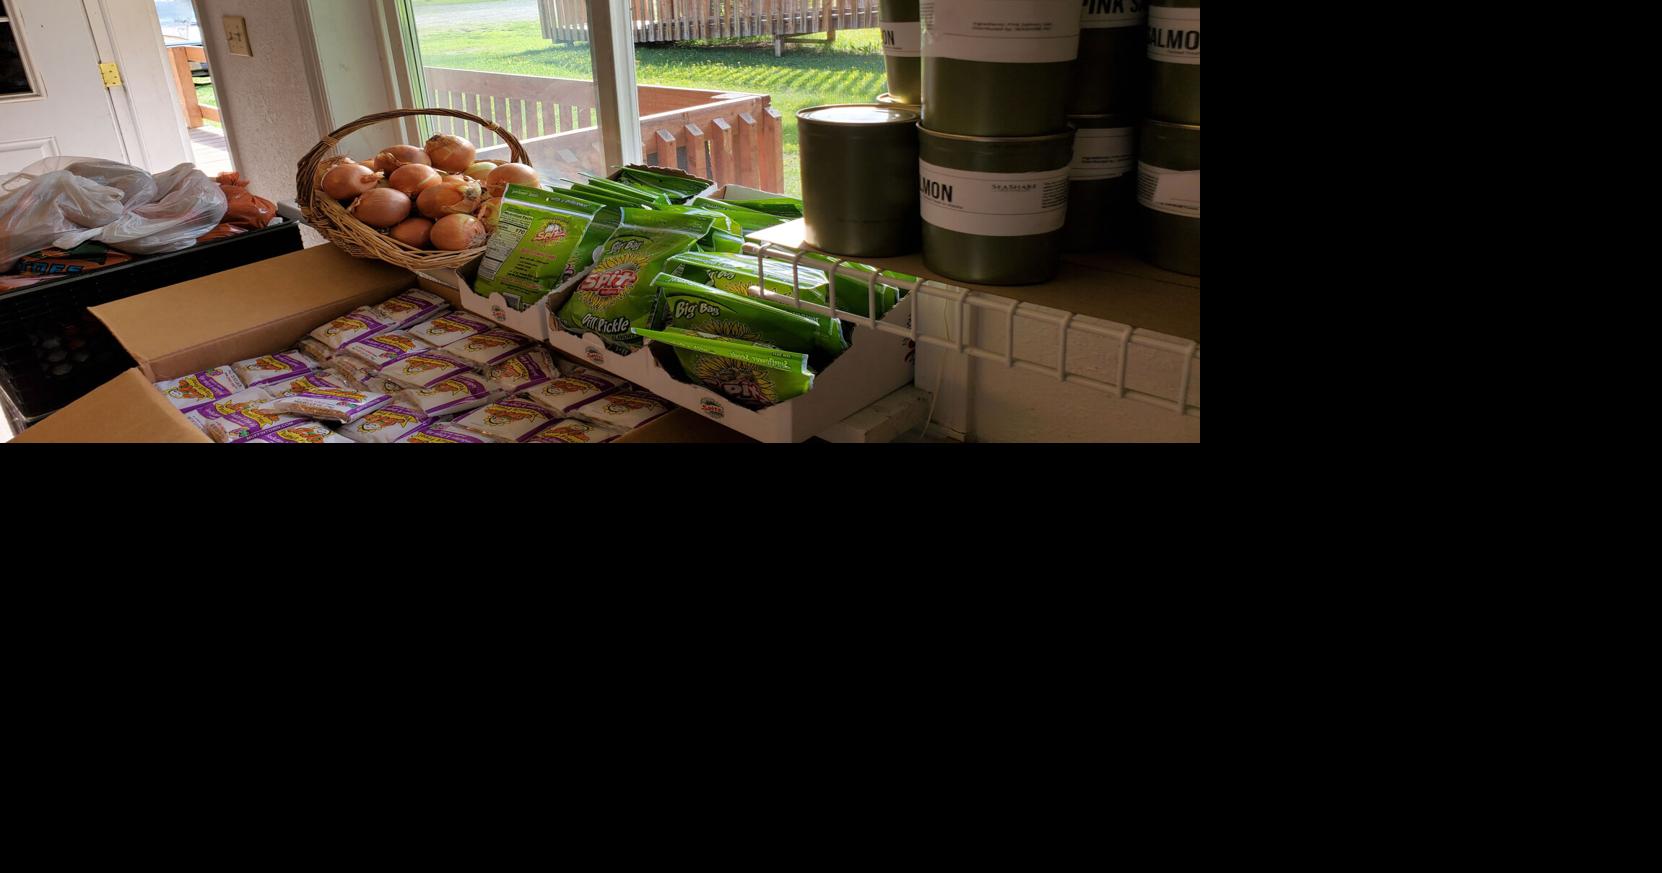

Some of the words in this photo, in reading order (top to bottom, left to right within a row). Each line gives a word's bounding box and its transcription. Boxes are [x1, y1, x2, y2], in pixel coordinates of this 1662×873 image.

[675, 301, 698, 319] Big
[700, 302, 720, 316] Bag
[582, 313, 599, 329] Dill
[598, 317, 630, 333] Pickle
